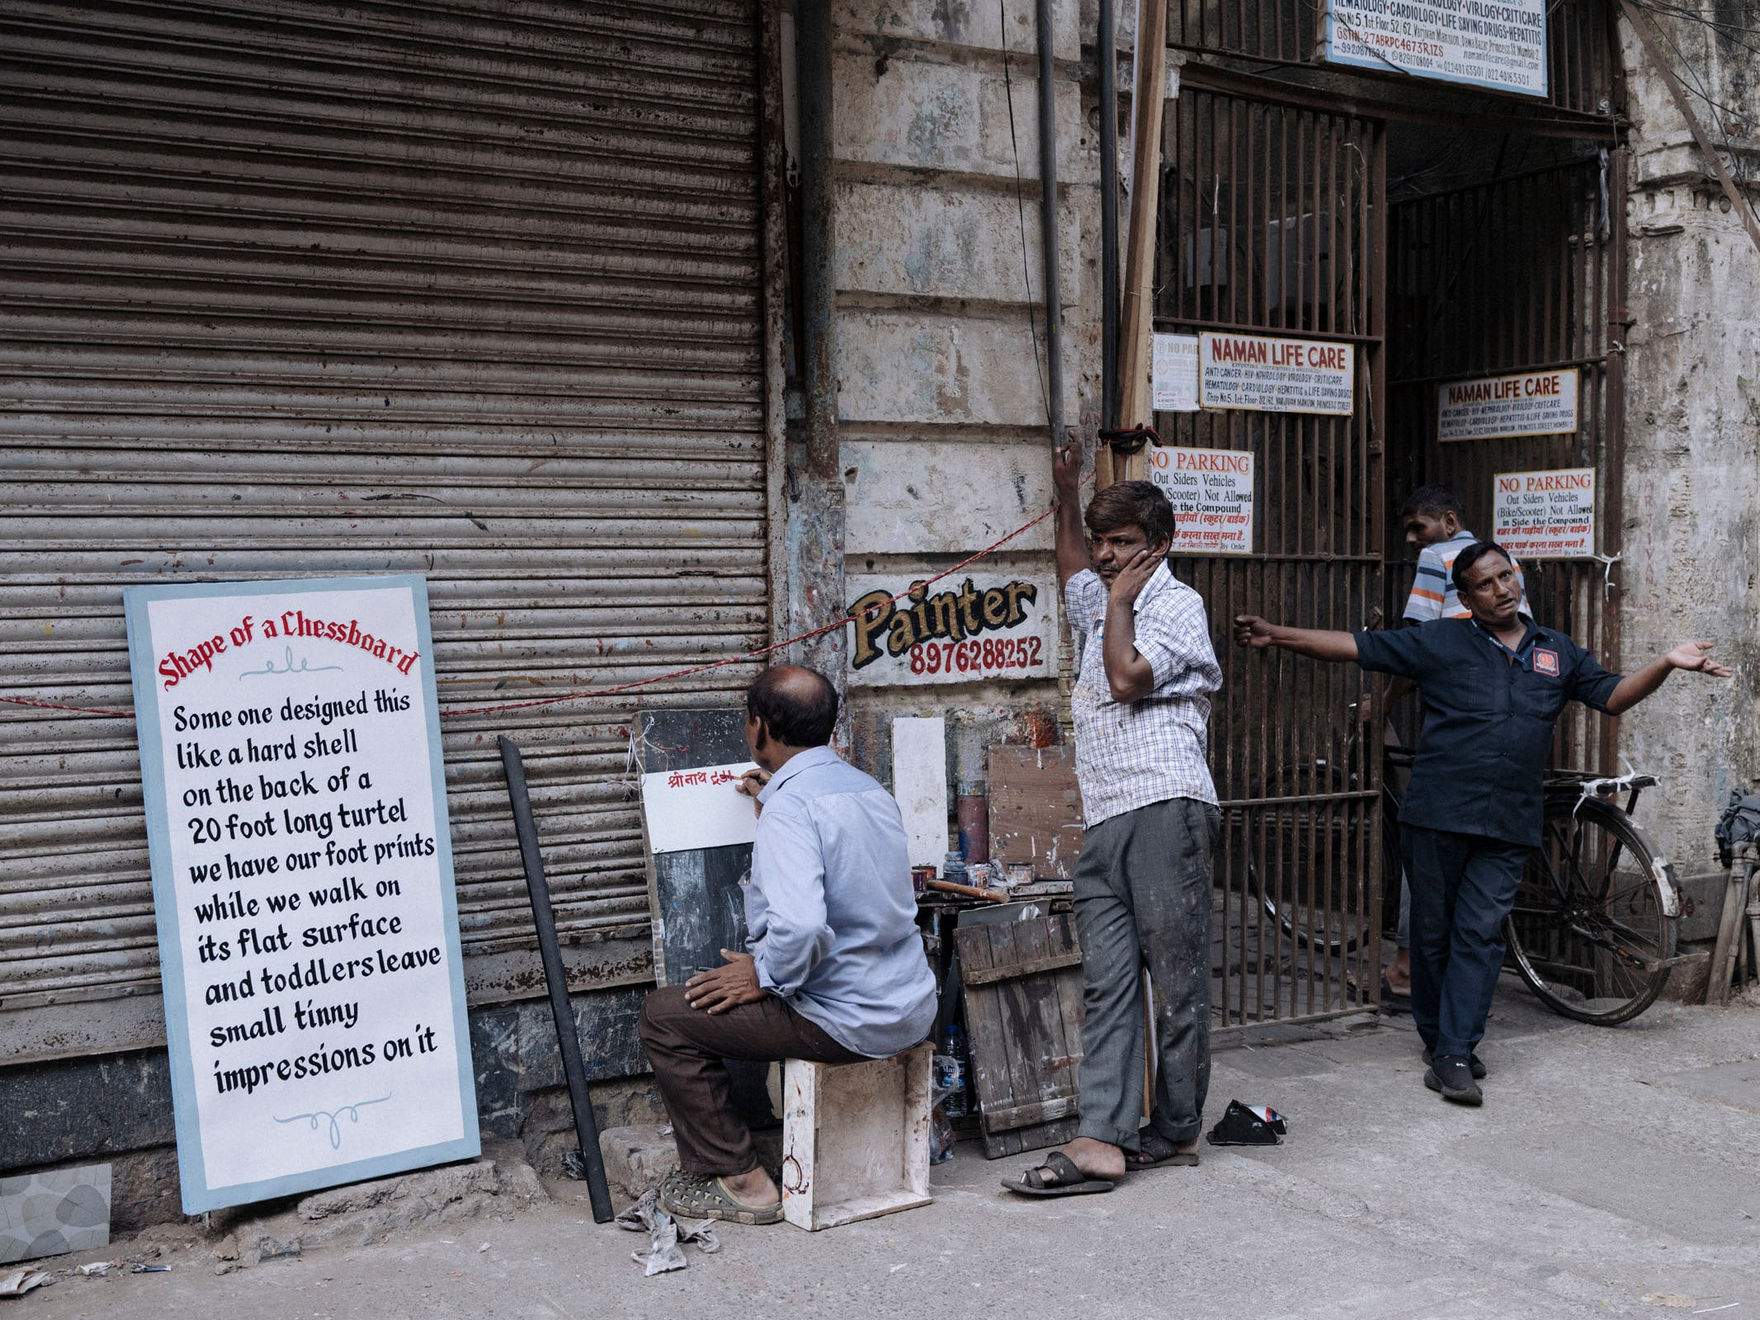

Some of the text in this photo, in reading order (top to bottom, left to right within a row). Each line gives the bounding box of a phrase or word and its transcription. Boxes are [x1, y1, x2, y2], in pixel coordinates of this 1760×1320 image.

[1390, 1, 1439, 25] CARDIOLOGY
[1441, 12, 1457, 30] LIFE
[1458, 16, 1482, 34] SAVING
[1483, 21, 1507, 39] DRUGS
[1508, 26, 1542, 46] HEPATITIS
[1465, 0, 1500, 20] VIRLOGY
[1501, 7, 1542, 28] CRITICARE
[1212, 337, 1267, 364] NAMAN
[1272, 343, 1304, 367] LIFE
[1308, 346, 1346, 370] CARE
[1220, 368, 1241, 379] CANCER
[1449, 382, 1492, 404] NAMAN
[1494, 380, 1521, 400] LIFE
[1525, 375, 1560, 396] CARE
[1153, 471, 1236, 487] Out Siders Vehicles
[1176, 452, 1250, 474] PARKING
[1499, 473, 1591, 492] NO PARKING
[1165, 487, 1252, 502] /Scooter) Not Allowed
[1180, 502, 1193, 511] the
[1196, 502, 1242, 514] Compound
[1506, 492, 1578, 505] Out Siders Vehicles
[1550, 505, 1563, 515] Not
[1567, 504, 1592, 514] Allowed
[1533, 517, 1546, 525] the
[1547, 516, 1589, 526] Compound
[847, 577, 1038, 670] Painter
[158, 610, 422, 692] Shape of a Chessboard
[909, 635, 1044, 675] 8976288252
[173, 687, 411, 732] Some one designed this
[176, 728, 358, 770] like a hard shell
[182, 765, 373, 807] on the back of a
[187, 797, 408, 845] 20 foot long turtel
[188, 832, 435, 885] we have our foot prints
[193, 876, 401, 924] while we walk on
[198, 912, 403, 964] its flat surface
[205, 947, 442, 1006] and toddlers leave
[209, 998, 359, 1048] small tinny
[212, 1023, 438, 1095] impressions on it
